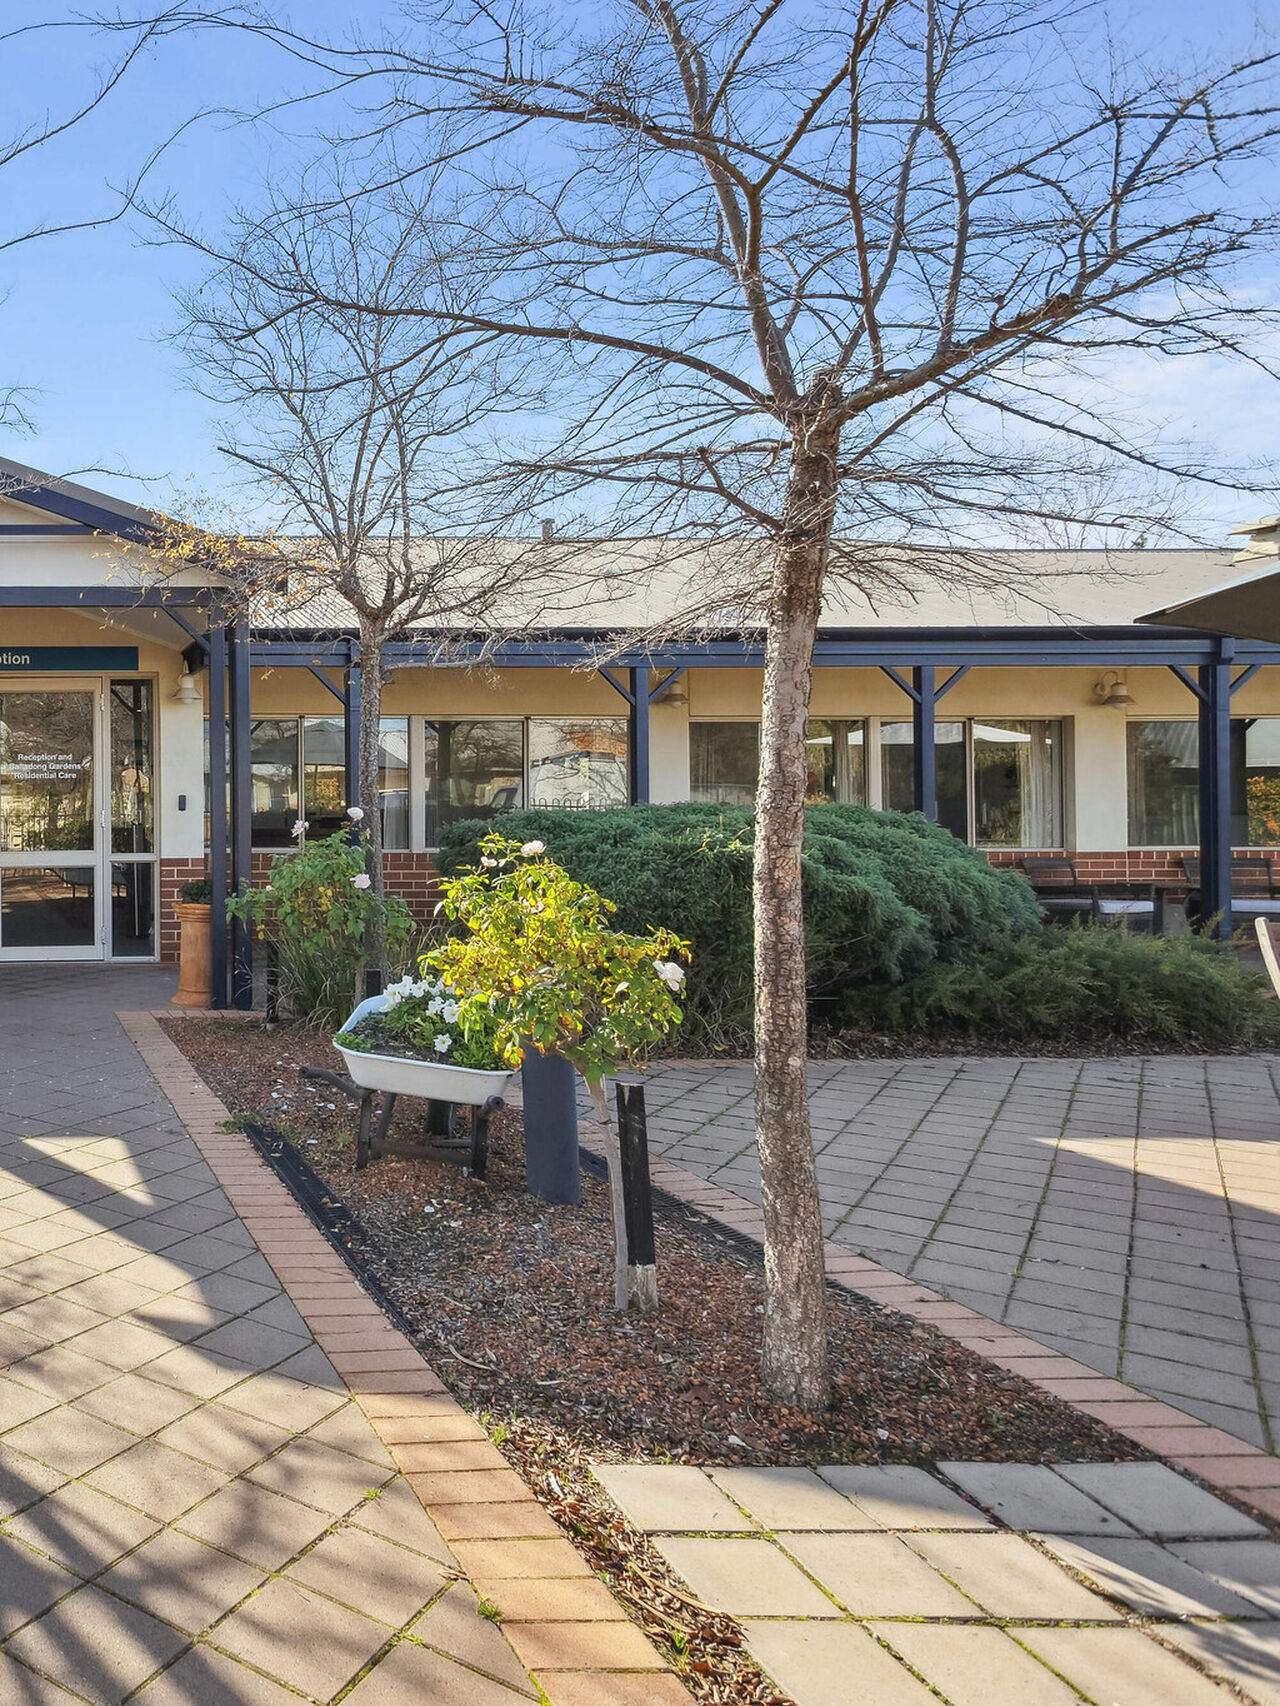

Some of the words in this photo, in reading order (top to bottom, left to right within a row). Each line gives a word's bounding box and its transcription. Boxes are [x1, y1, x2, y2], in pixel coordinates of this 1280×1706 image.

[17, 753, 56, 762] Reception
[57, 753, 73, 761] and
[48, 762, 81, 770] Gardens
[58, 771, 77, 779] Care
